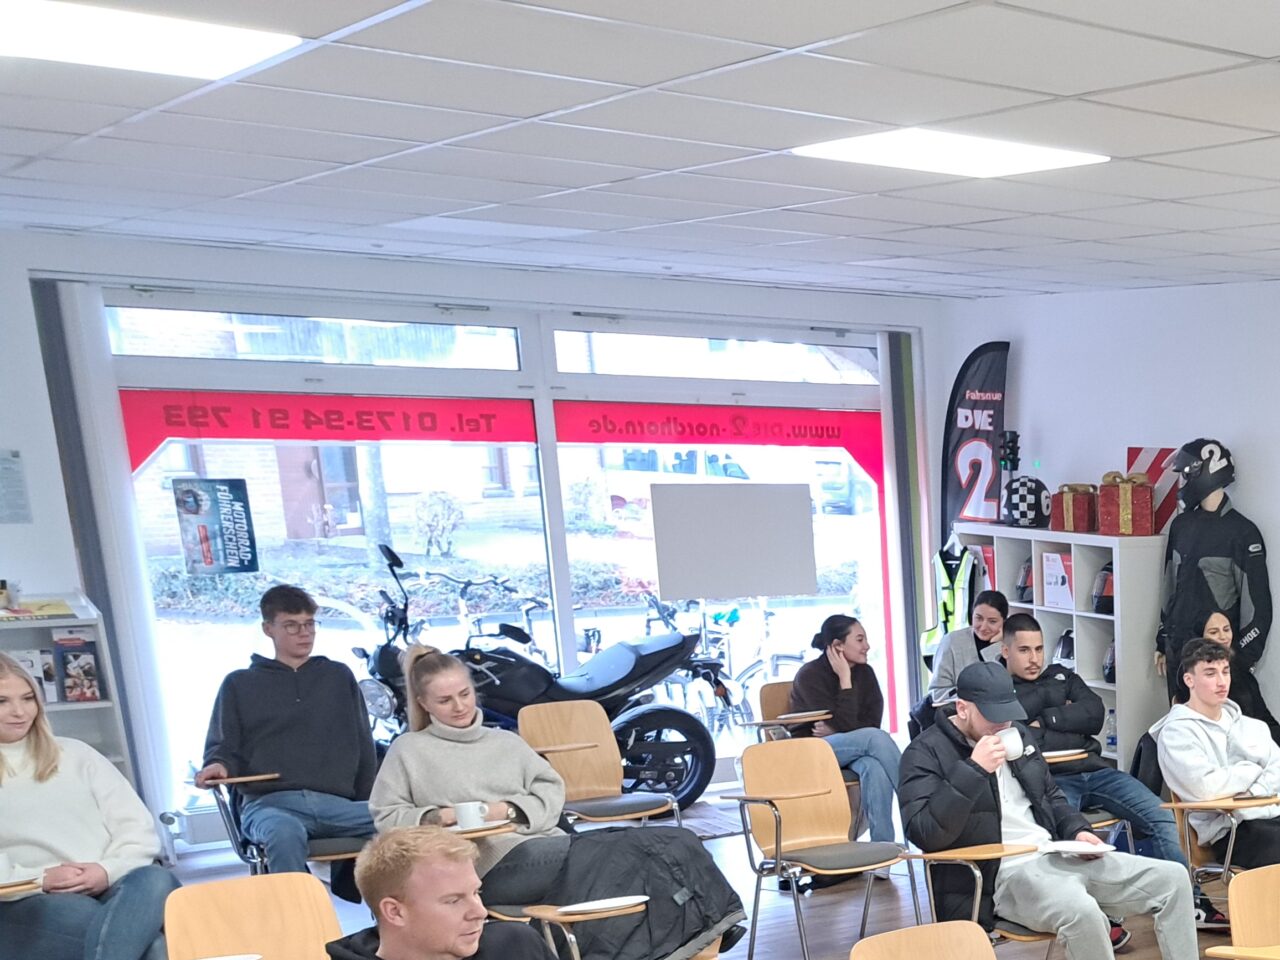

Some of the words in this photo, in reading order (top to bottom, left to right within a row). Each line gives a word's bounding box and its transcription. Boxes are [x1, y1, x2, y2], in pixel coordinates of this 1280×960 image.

[957, 407, 994, 431] DIE
[1201, 443, 1228, 474] 2
[955, 438, 999, 521] 2
[1040, 490, 1052, 516] 6
[231, 500, 252, 566] MOTORRAD-
[1239, 627, 1261, 648] SHOEI
